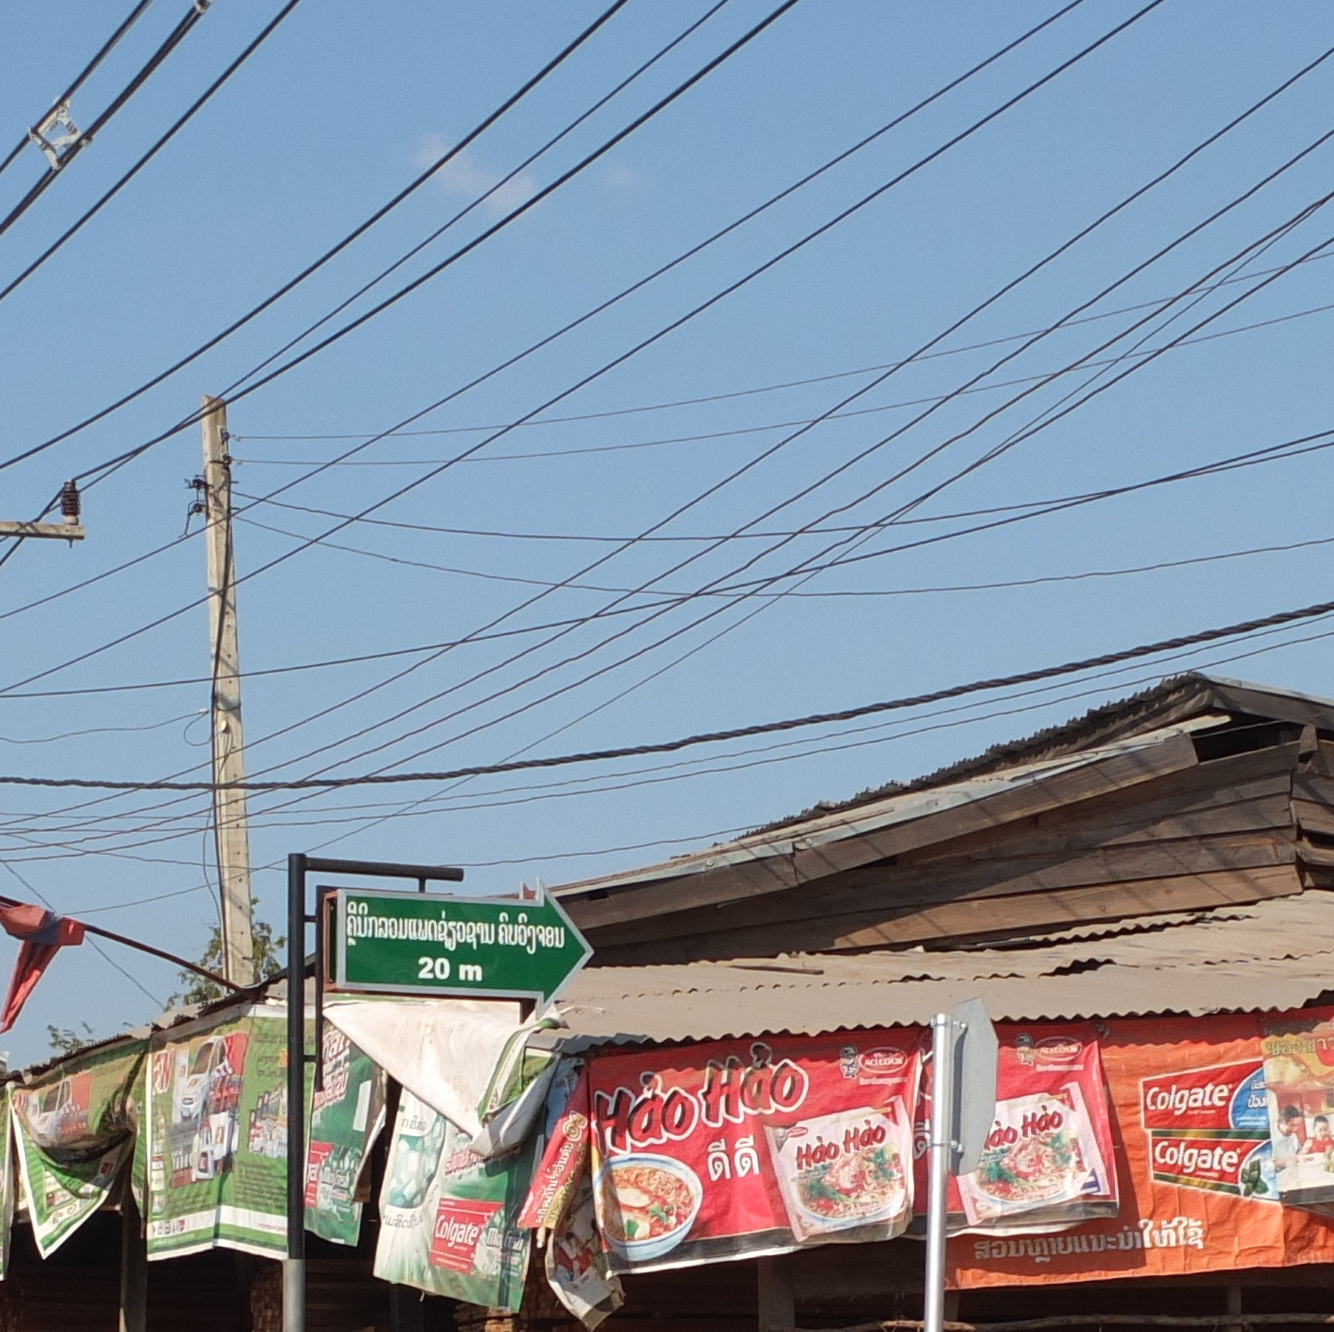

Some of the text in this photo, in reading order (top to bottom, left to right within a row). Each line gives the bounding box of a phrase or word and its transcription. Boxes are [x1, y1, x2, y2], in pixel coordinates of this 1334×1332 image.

[418, 957, 483, 981] 20 m
[1147, 1083, 1229, 1115] Colgate
[708, 1134, 761, 1182] ดีดี
[1155, 1141, 1238, 1173] Colgate
[436, 1215, 479, 1248] Colgate
